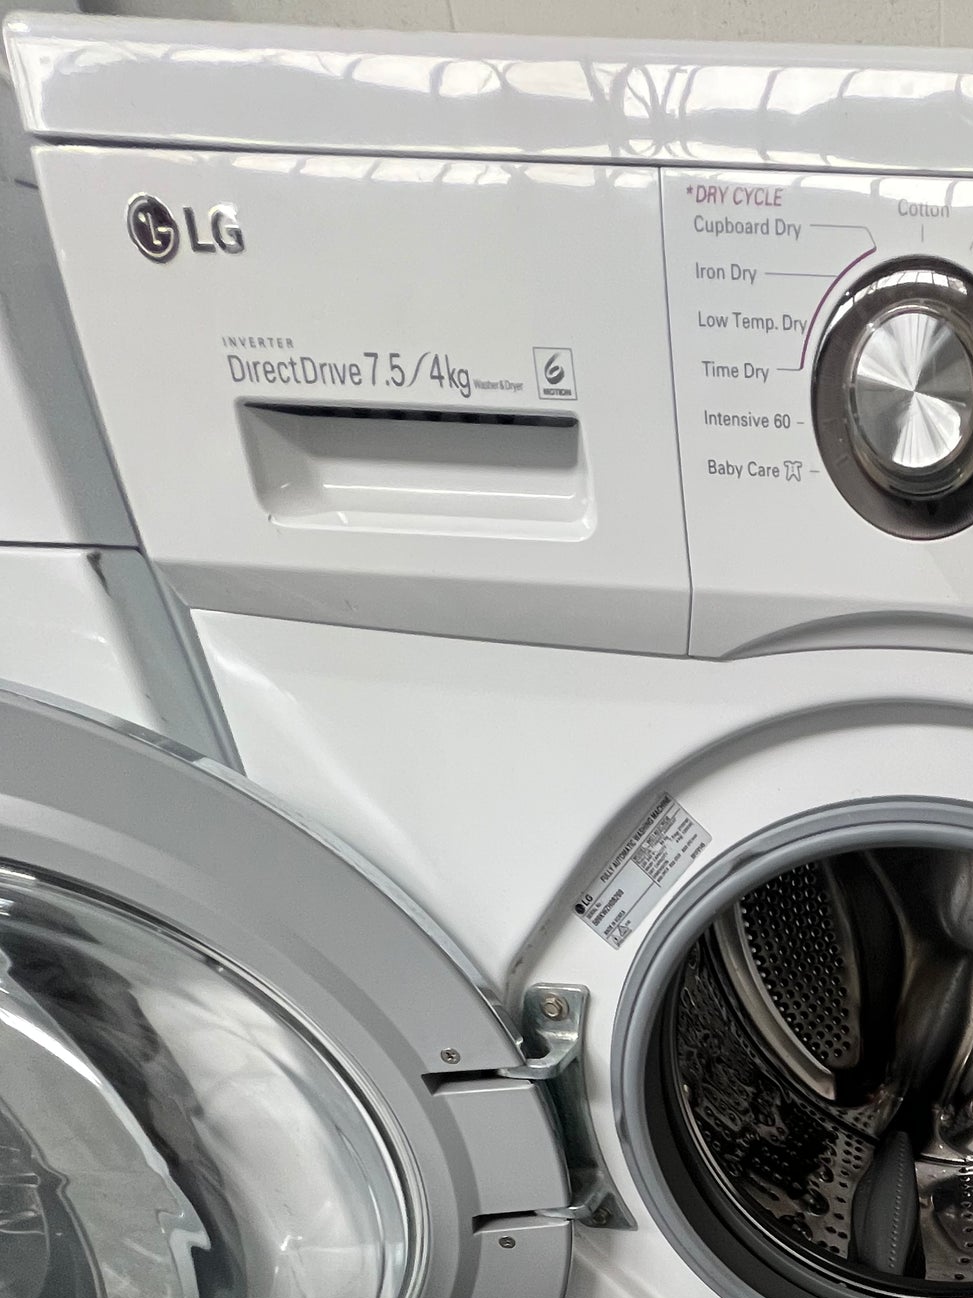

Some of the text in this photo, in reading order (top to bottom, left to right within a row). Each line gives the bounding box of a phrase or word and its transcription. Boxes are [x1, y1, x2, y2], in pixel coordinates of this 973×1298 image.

[732, 187, 783, 206] CYCLE
[898, 199, 950, 217] Cotton
[183, 203, 244, 254] LG
[694, 215, 801, 240] Cupboard Dry
[695, 262, 757, 285] Iron Dry
[698, 311, 807, 335] Low Temp. Dry
[222, 336, 295, 349] INVERTER
[702, 360, 769, 384] Time Dry
[704, 410, 791, 429] Intensive 60
[708, 459, 780, 479] Baby Care
[600, 866, 616, 883] FULLY
[612, 839, 637, 869] AUTOMATIC
[633, 817, 654, 842] WASHING
[649, 796, 671, 820] MACHINE
[582, 893, 594, 907] LG
